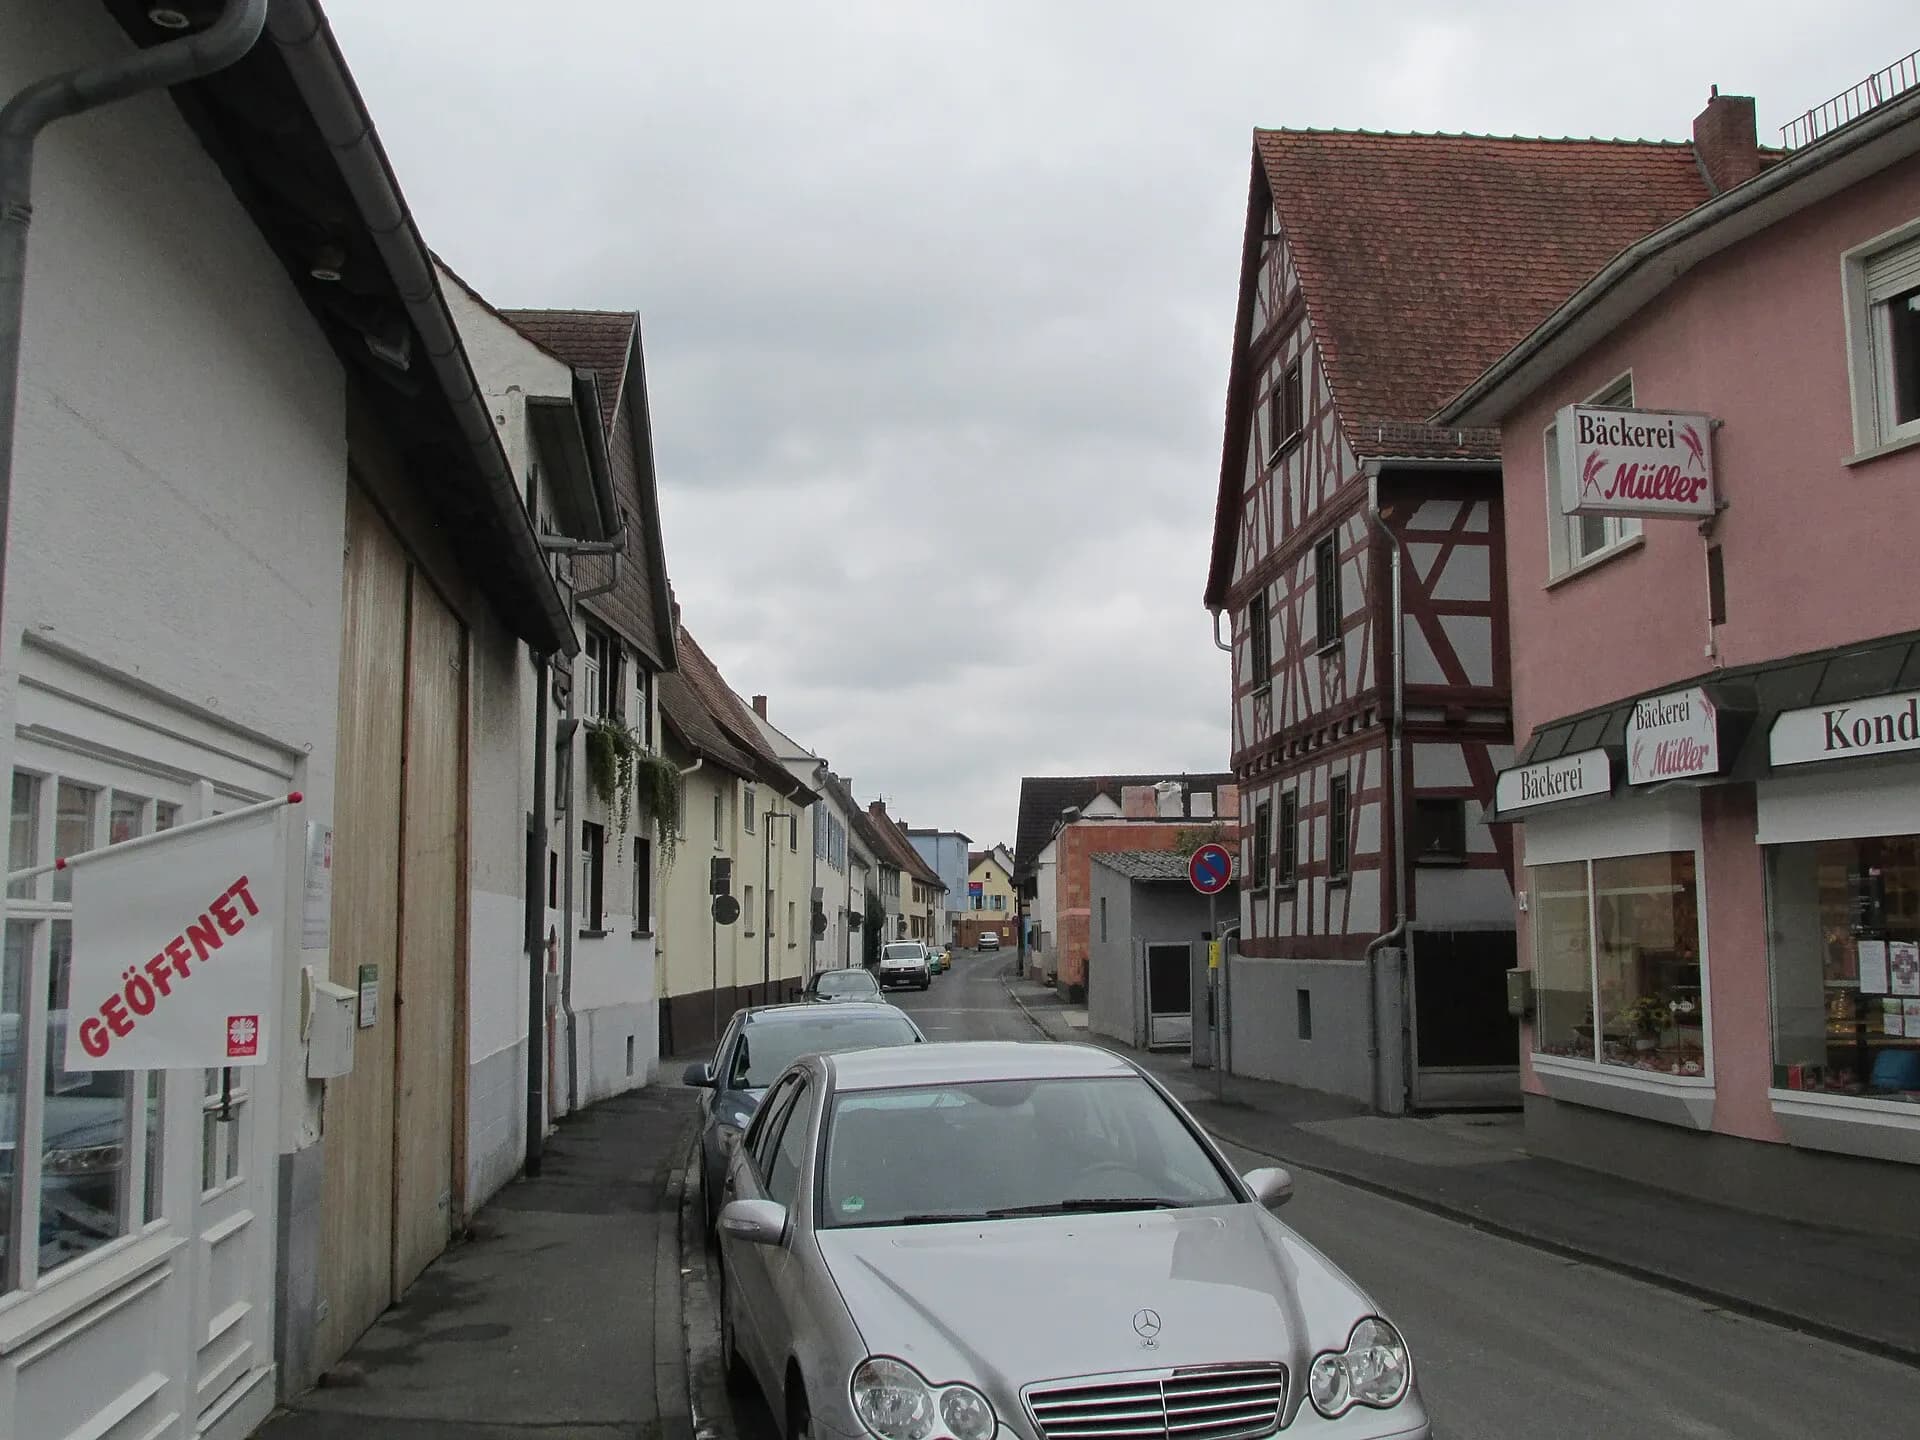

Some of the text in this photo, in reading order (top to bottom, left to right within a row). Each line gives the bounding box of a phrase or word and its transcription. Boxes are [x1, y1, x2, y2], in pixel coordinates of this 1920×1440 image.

[1578, 415, 1675, 448] Bäckerei
[1604, 463, 1707, 503] Müller
[1636, 694, 1690, 730] Bäckerei
[1650, 737, 1709, 777] Müller
[1520, 758, 1583, 801] Bäckerei
[79, 875, 259, 1058] GEÖFFNET
